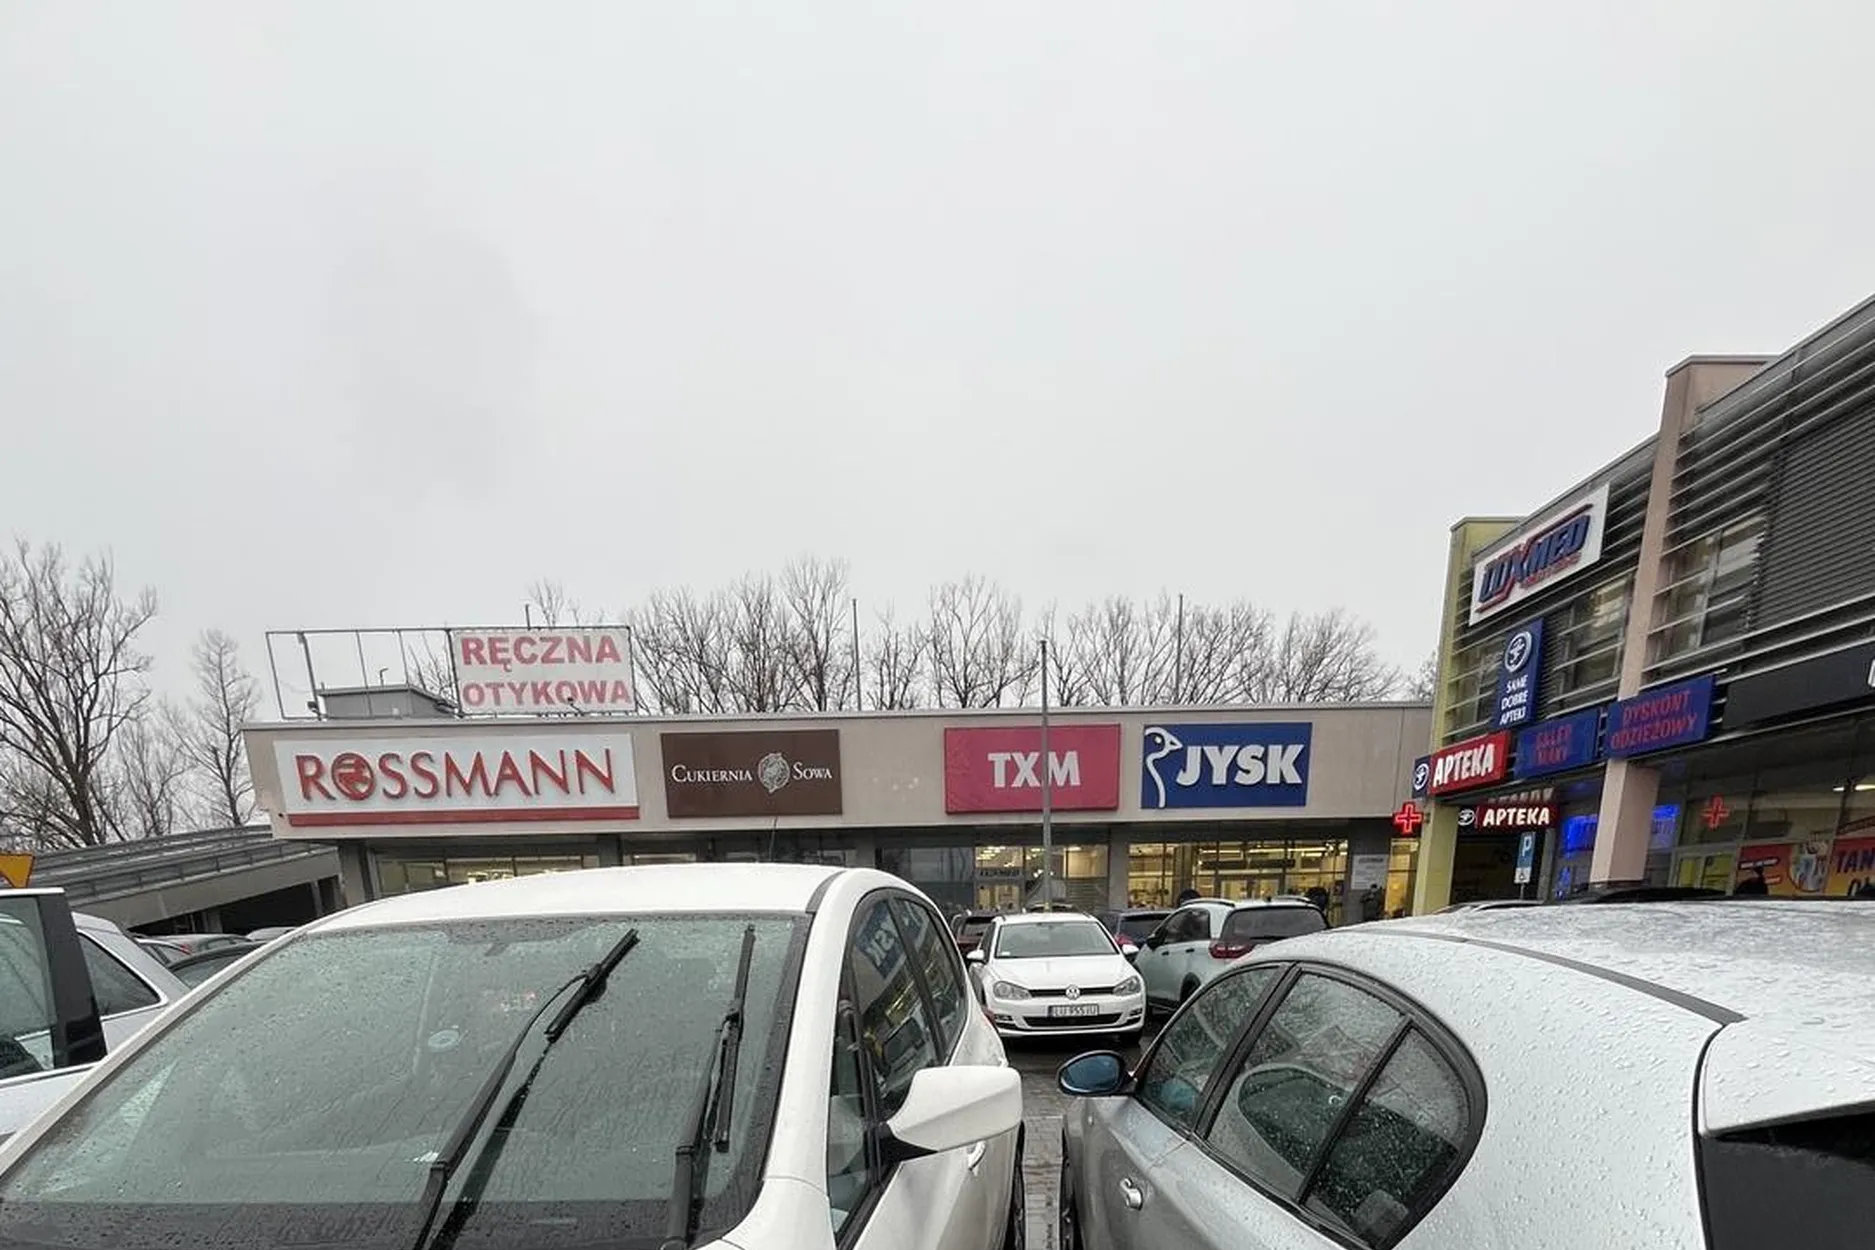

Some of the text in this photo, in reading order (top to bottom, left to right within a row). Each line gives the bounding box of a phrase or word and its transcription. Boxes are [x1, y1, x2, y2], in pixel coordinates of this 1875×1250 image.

[461, 634, 622, 672] RĘCZNA
[462, 679, 631, 707] OTYKOWA
[295, 748, 615, 802] ROSSMANN
[671, 761, 833, 783] CUKIERNIA SOWA
[987, 750, 1081, 788] TXM
[1175, 743, 1305, 786] JYSK
[1432, 743, 1495, 787] APTEKA
[1483, 806, 1550, 827] APTEKA
[1522, 836, 1532, 857] P
